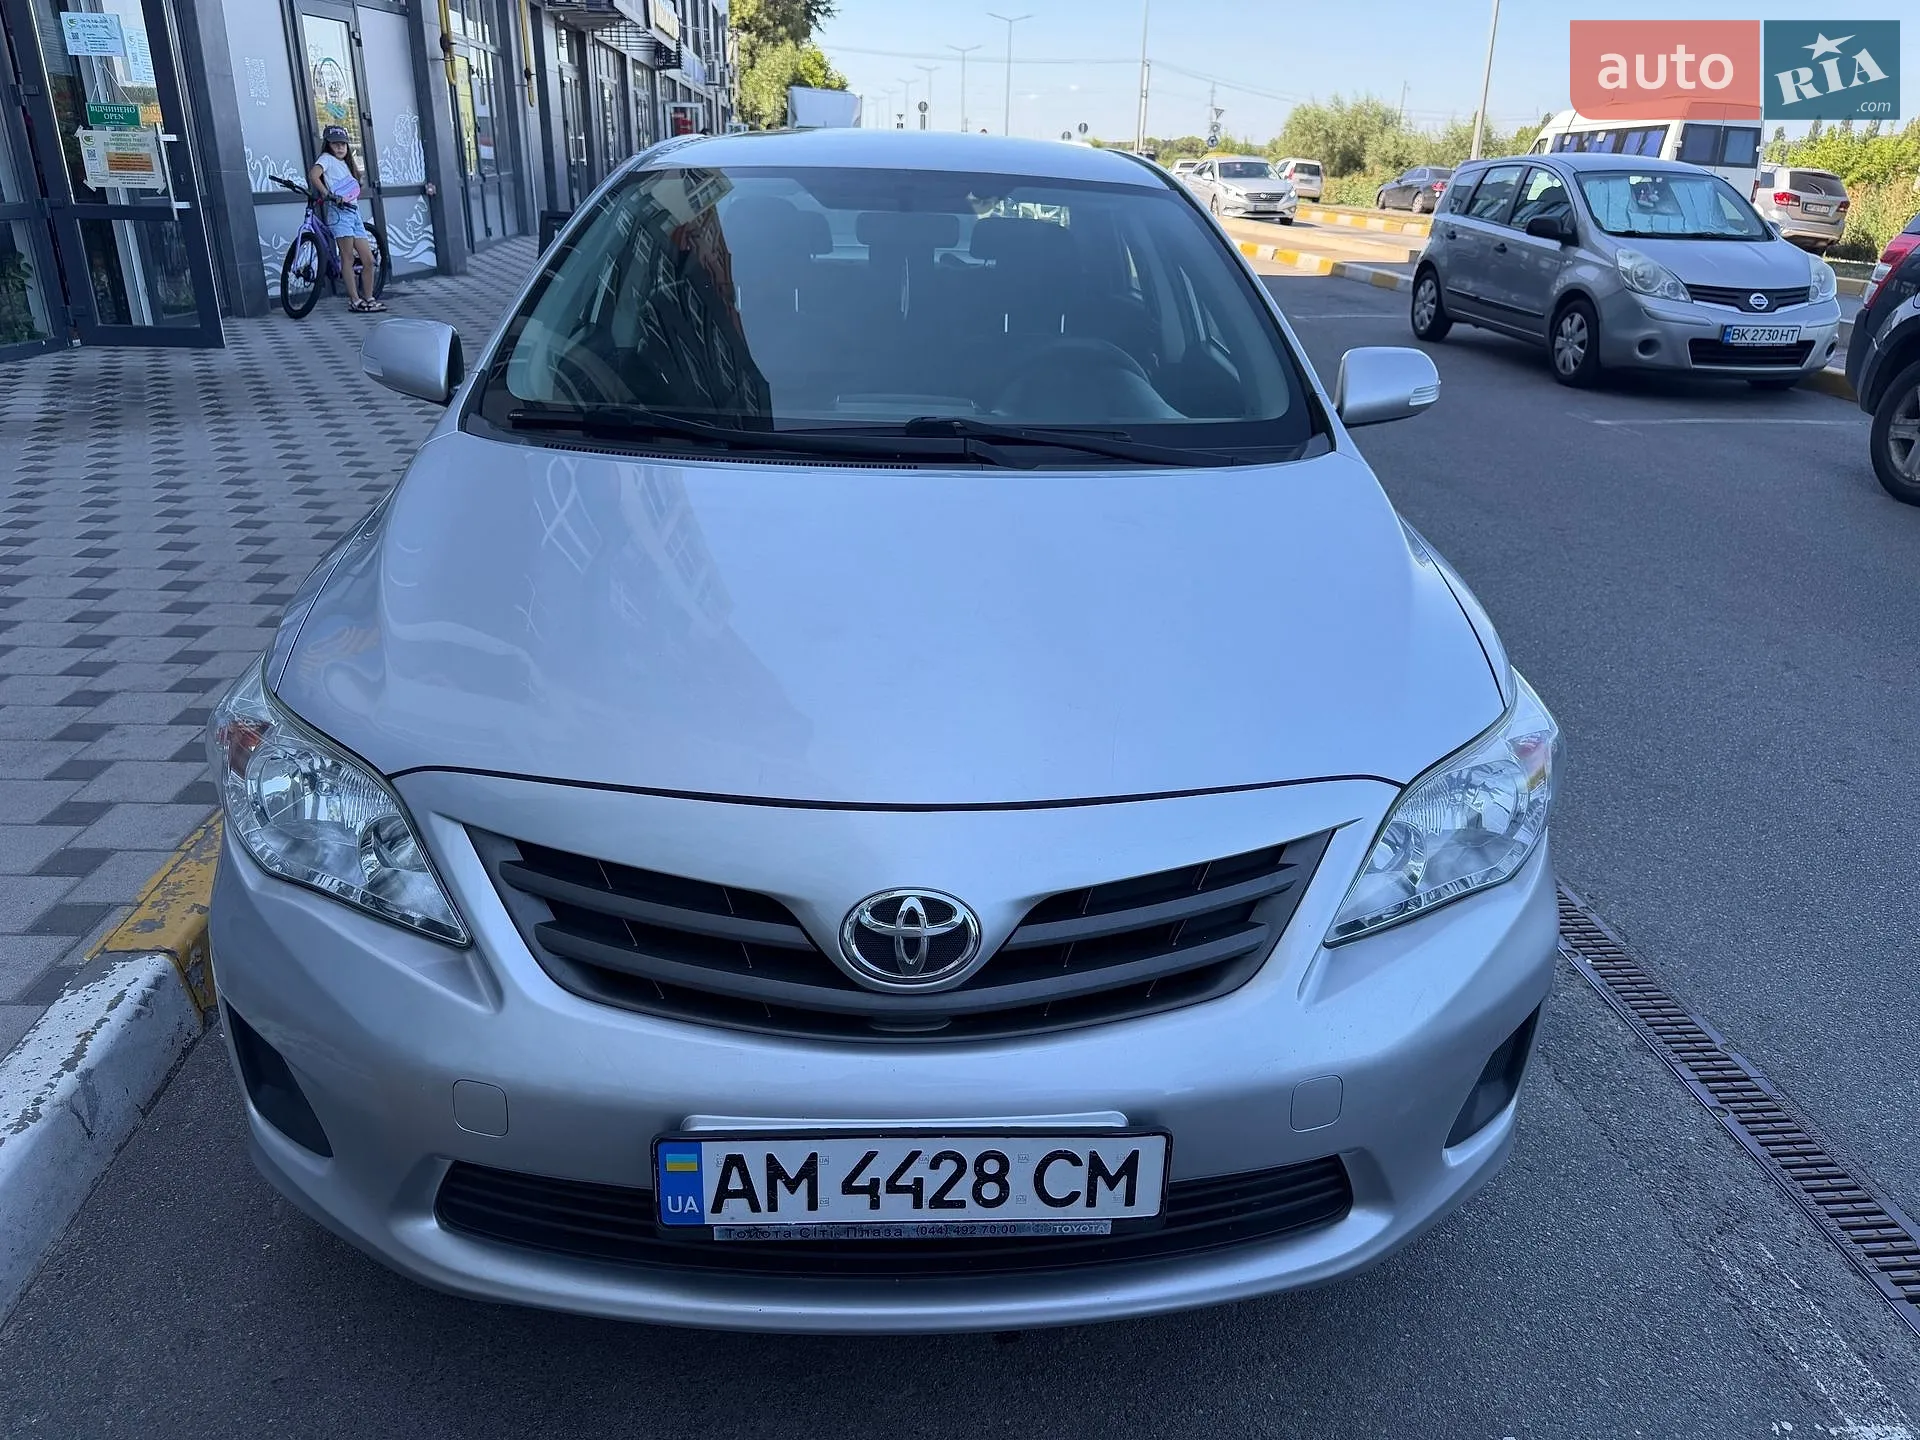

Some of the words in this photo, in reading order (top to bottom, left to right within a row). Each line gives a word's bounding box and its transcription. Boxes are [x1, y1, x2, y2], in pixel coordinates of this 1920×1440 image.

[1732, 329, 1749, 340] BK
[1751, 329, 1780, 341] 2730
[1780, 330, 1798, 341] HT
[710, 1151, 819, 1214] AM
[841, 1149, 1010, 1210] 4428
[1033, 1149, 1140, 1208] CM
[667, 1195, 700, 1213] UA
[953, 1224, 977, 1235] 492
[1002, 1224, 1017, 1234] 00
[1054, 1224, 1105, 1234] TOYOTA
